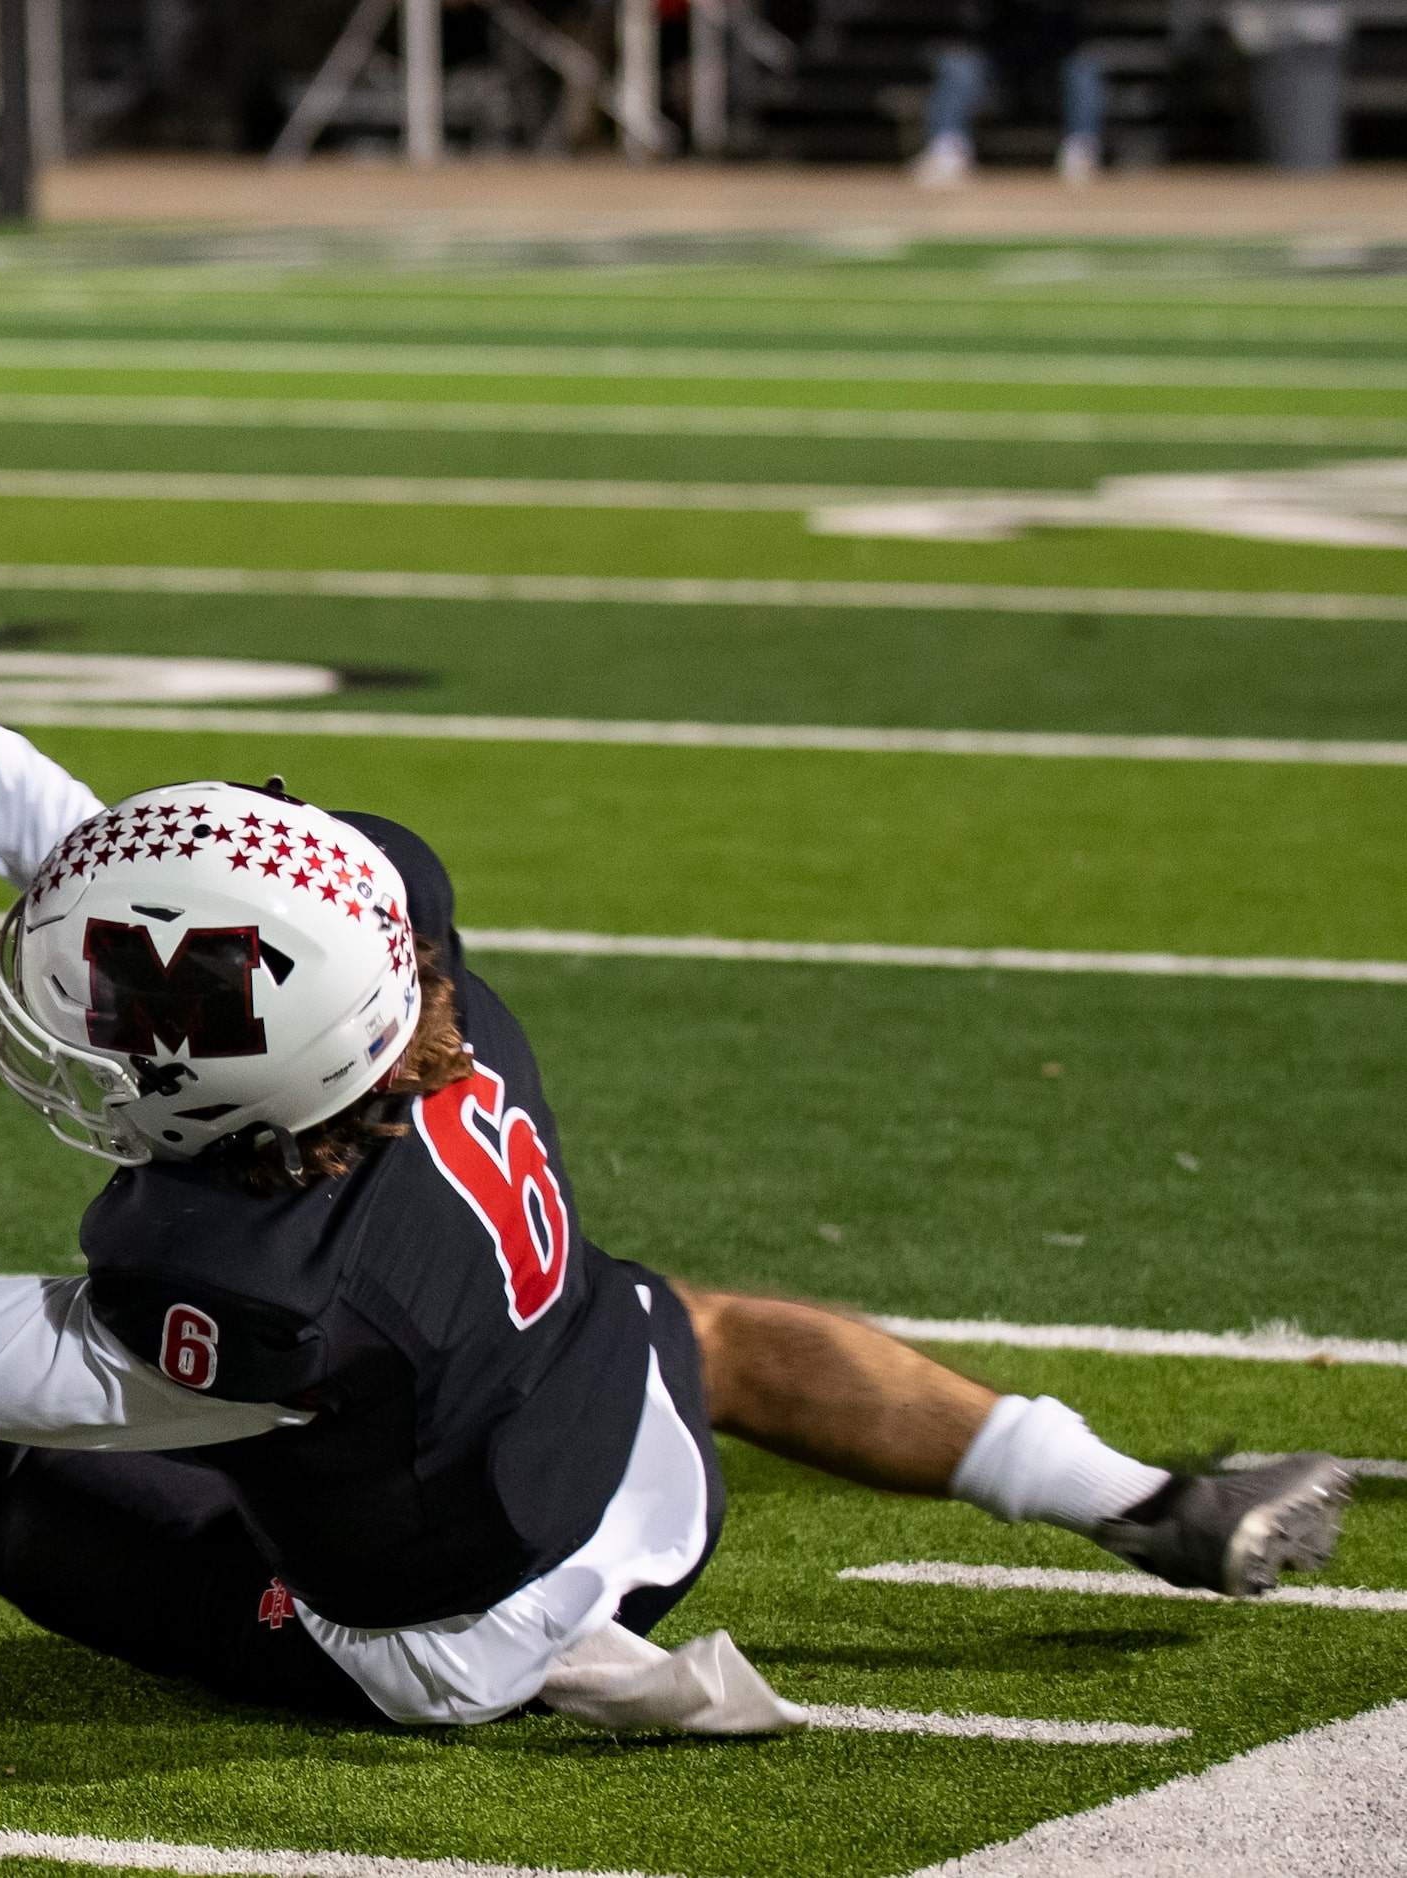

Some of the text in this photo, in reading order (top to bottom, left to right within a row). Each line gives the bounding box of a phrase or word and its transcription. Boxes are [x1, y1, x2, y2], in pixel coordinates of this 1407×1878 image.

[83, 917, 267, 1058] M
[411, 1045, 570, 1330] 6
[160, 1302, 219, 1389] 6
